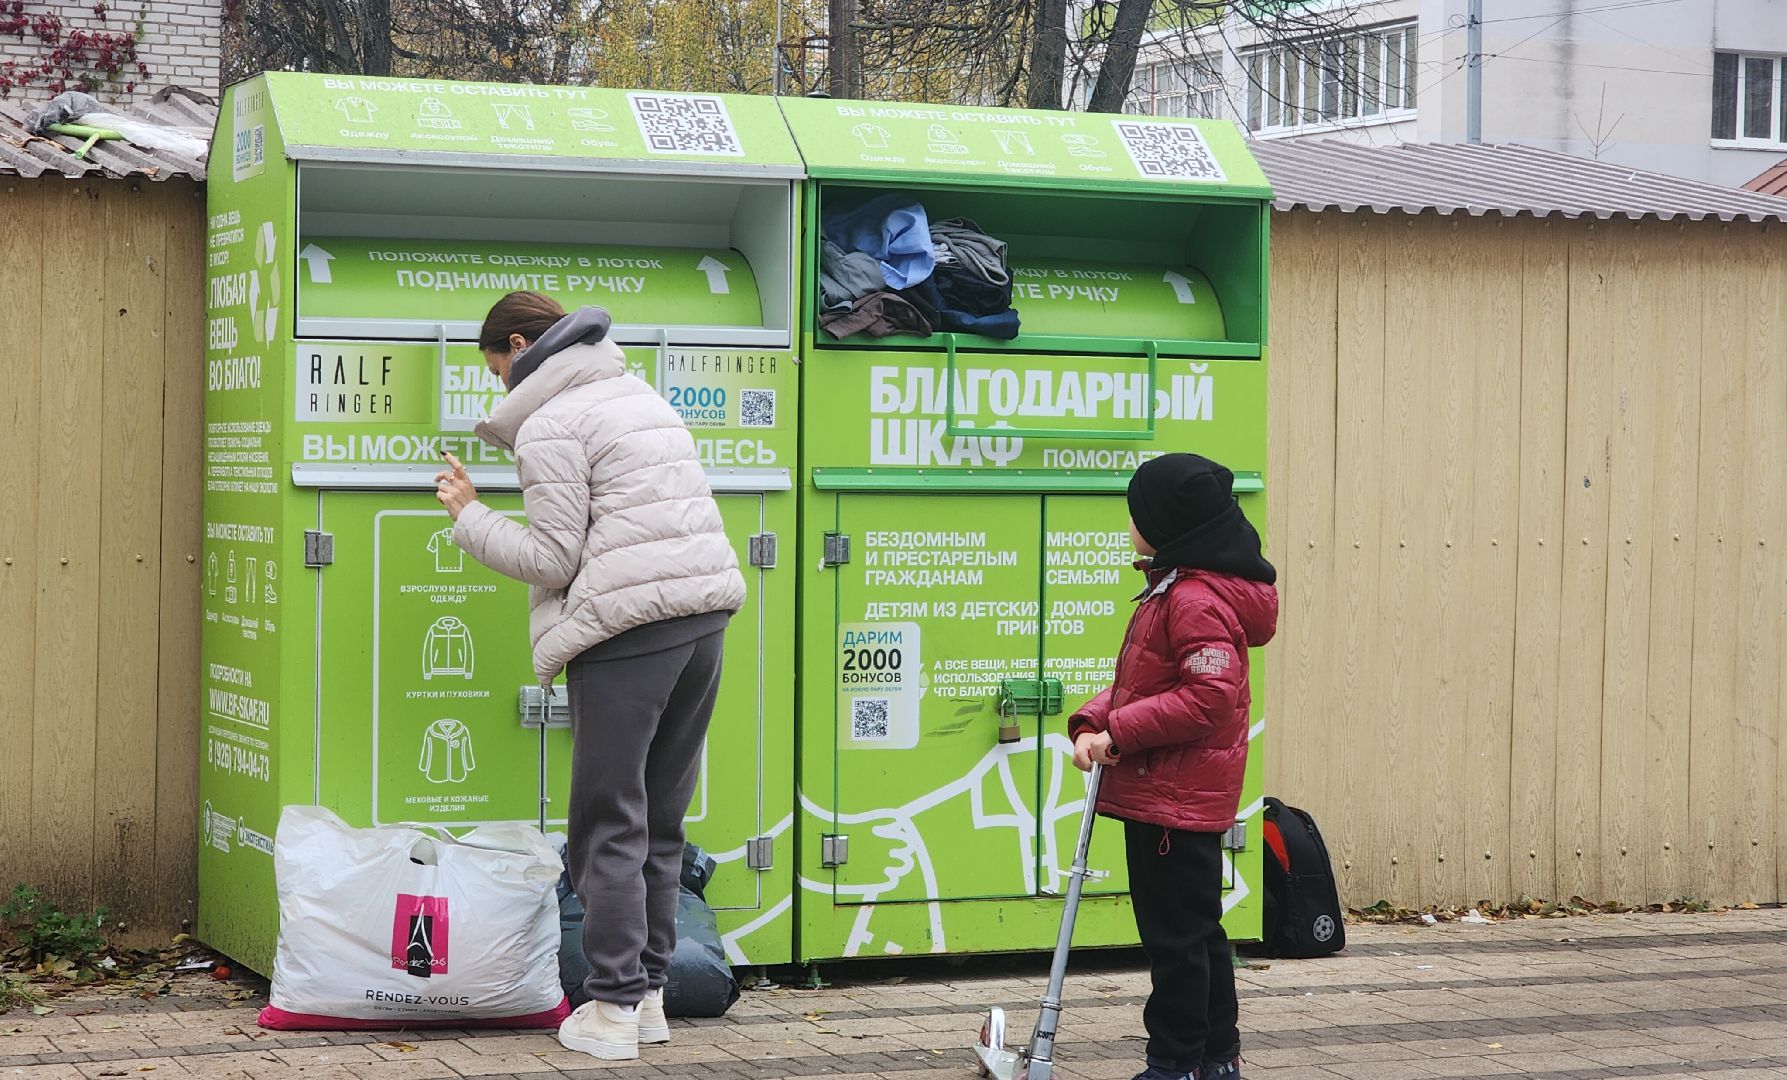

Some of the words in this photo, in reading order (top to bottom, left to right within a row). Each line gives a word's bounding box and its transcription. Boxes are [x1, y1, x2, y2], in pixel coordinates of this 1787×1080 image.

[323, 78, 355, 90] ВЫ
[360, 79, 446, 95] МОЖЕТЕ
[450, 84, 549, 99] ОСТАВИТЬ
[554, 89, 589, 101] ТУТ
[836, 106, 865, 117] ВЫ
[870, 108, 948, 121] МОЖЕТЕ
[952, 111, 1041, 126] ОСТАВИТЬ
[1044, 116, 1077, 128] ТУТ
[339, 128, 391, 140] Одежду
[580, 138, 618, 149] Обувь
[368, 250, 484, 265] ПОЛОЖИТЕ
[488, 254, 571, 268] ОДЕЖДУ
[578, 257, 592, 267] В
[597, 258, 664, 270] ЛОТОК
[396, 269, 560, 292] ПОДНИМИТЕ
[566, 274, 646, 293] РУЧКУ
[1012, 266, 1049, 279] ЖДУ
[1055, 269, 1069, 278] В
[1072, 270, 1132, 282] ЛОТОК
[209, 272, 246, 309] ЛЮБАЯ
[1047, 284, 1120, 303] РУЧКУ
[209, 316, 238, 355] ВЕЩЬ
[209, 359, 223, 392] ВО
[224, 355, 261, 391] БЛАГО!
[310, 354, 393, 386] RALF
[669, 386, 726, 408] 2000
[869, 362, 1214, 421] БЛАГОДАРНЫЙ
[310, 393, 393, 415] RINGER
[676, 409, 726, 419] ОНУСОВ
[303, 434, 355, 461] ВЫ
[361, 435, 498, 462] МОЖЕТЕ
[695, 438, 777, 467] ДЕСЬ
[869, 419, 1024, 467] ШКАФ
[1043, 448, 1166, 469] ПОМОГАЕ
[207, 522, 215, 538] ВЫ
[215, 522, 237, 540] МОЖЕТЕ
[237, 523, 263, 544] ОСТАВИТЬ
[865, 531, 986, 549] БЕЗДОМНЫМ
[1046, 531, 1130, 549] МНОГОДЕ
[865, 552, 878, 566] И
[883, 551, 1017, 567] ПРЕСТАРЕЛЫМ
[865, 570, 983, 588] ГРАЖДАНАМ
[1046, 569, 1119, 585] СЕМЬЯМ
[400, 585, 448, 594] ВЗРОСЛУЮ
[449, 585, 456, 593] И
[456, 585, 497, 594] ДЕТСКУЮ
[430, 594, 467, 603] ОДЕЖДУ
[864, 602, 928, 621] ДЕТЯМ
[933, 602, 957, 617] ИЗ
[1051, 600, 1116, 619] ДОМОВ
[996, 620, 1085, 636] ПРИЮТОВ
[843, 631, 902, 648] ДАРИМ
[843, 648, 902, 671] 2000
[933, 660, 943, 671] А
[945, 660, 968, 670] ВСЕ
[971, 660, 1008, 671] ВЕЩИ,
[842, 672, 902, 683] БОНУСОВ
[1075, 672, 1083, 681] В
[406, 691, 438, 699] КУРТКИ
[438, 691, 445, 699] И
[446, 690, 490, 698] ПУХОВИКИ
[933, 687, 957, 697] ЧТО
[209, 688, 270, 726] WWW.BF-SKAF.RU
[208, 738, 213, 764] 8
[214, 739, 232, 776] (926)
[232, 746, 270, 783] 794-04-73
[405, 796, 442, 804] МЕХОВЫЕ
[443, 796, 450, 804] И
[450, 795, 489, 804] КОЖАНЫЕ
[429, 804, 465, 813] ИЗДЕЛИЯ
[392, 956, 447, 969] Rendez-Vous
[365, 989, 470, 1006] RENDEZ-VOUS
